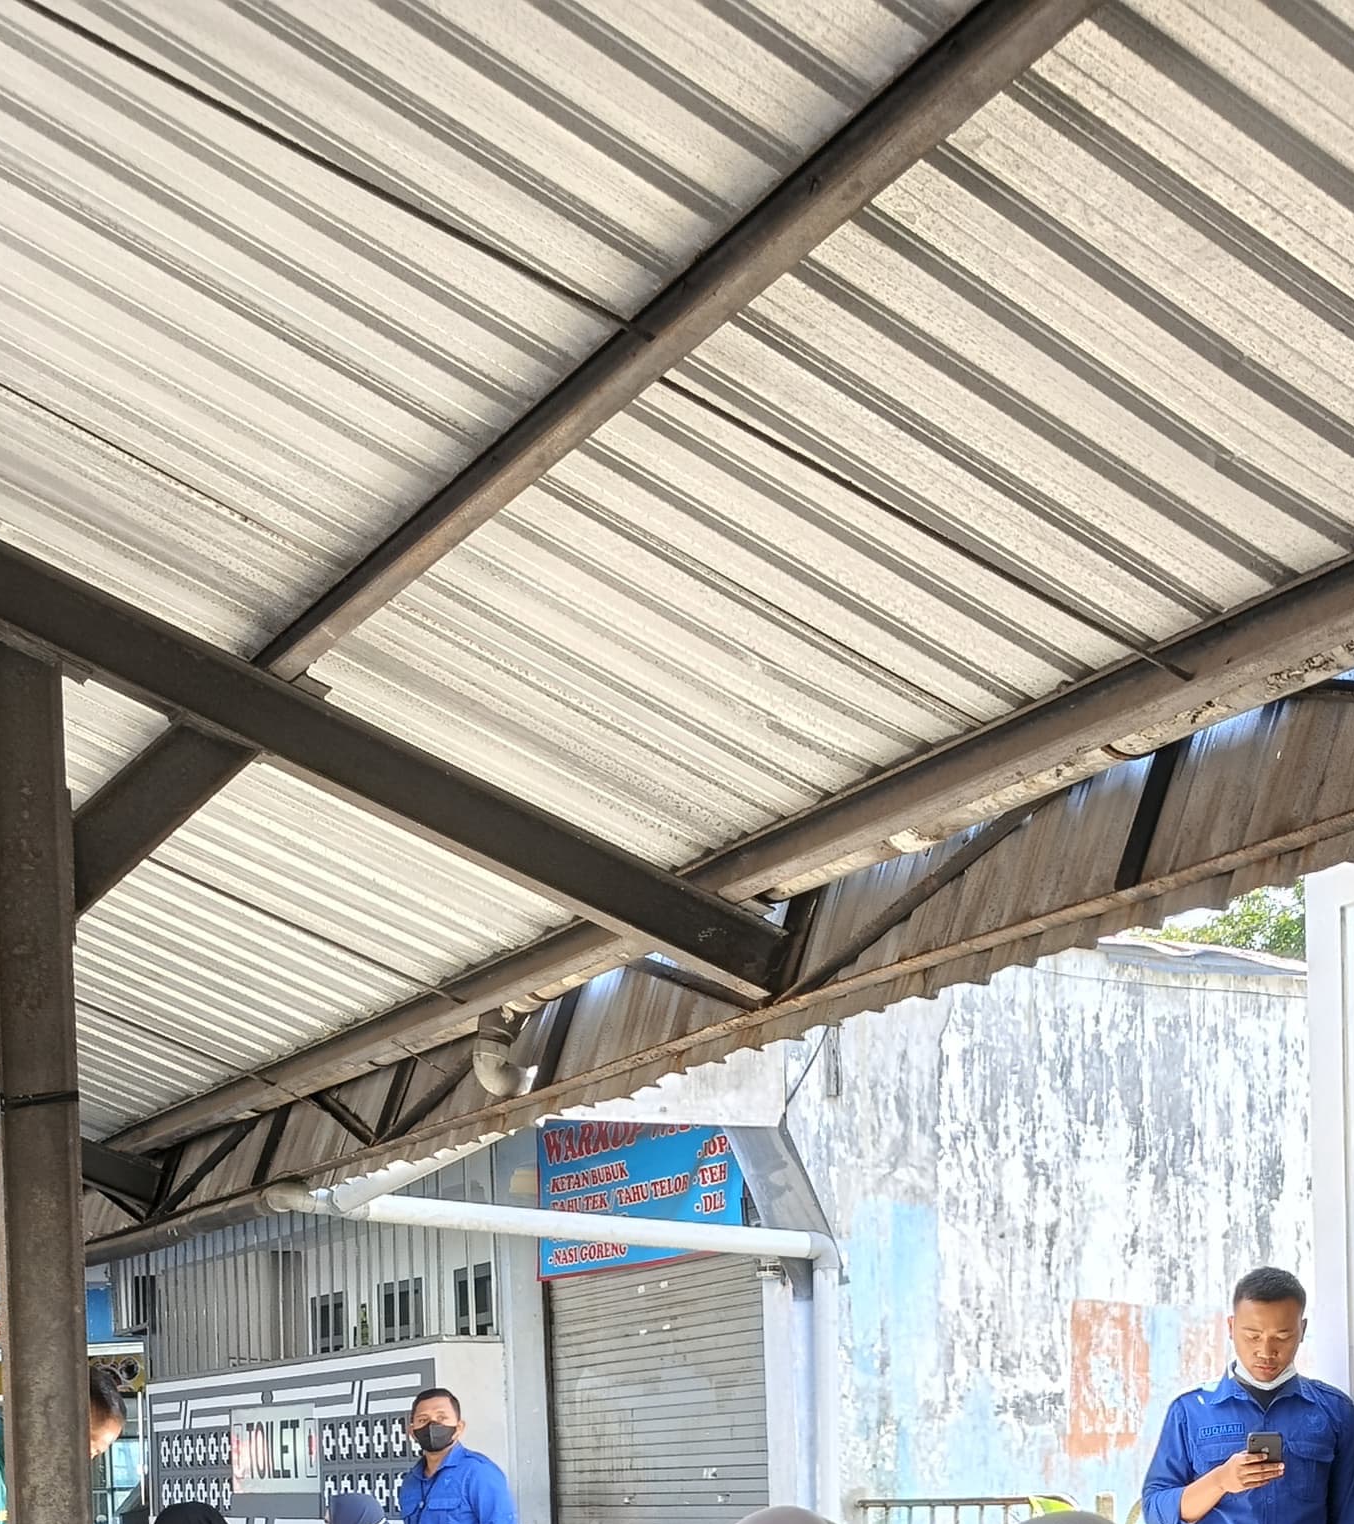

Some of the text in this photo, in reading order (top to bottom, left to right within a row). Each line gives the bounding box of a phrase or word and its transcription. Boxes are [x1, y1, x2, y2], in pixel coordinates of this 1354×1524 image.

[550, 1162, 629, 1193] KETAN BUBUK
[699, 1163, 727, 1185] TEH
[617, 1184, 649, 1205] TAHU
[553, 1243, 628, 1265] NASI GORENG
[246, 1419, 299, 1479] TOILET
